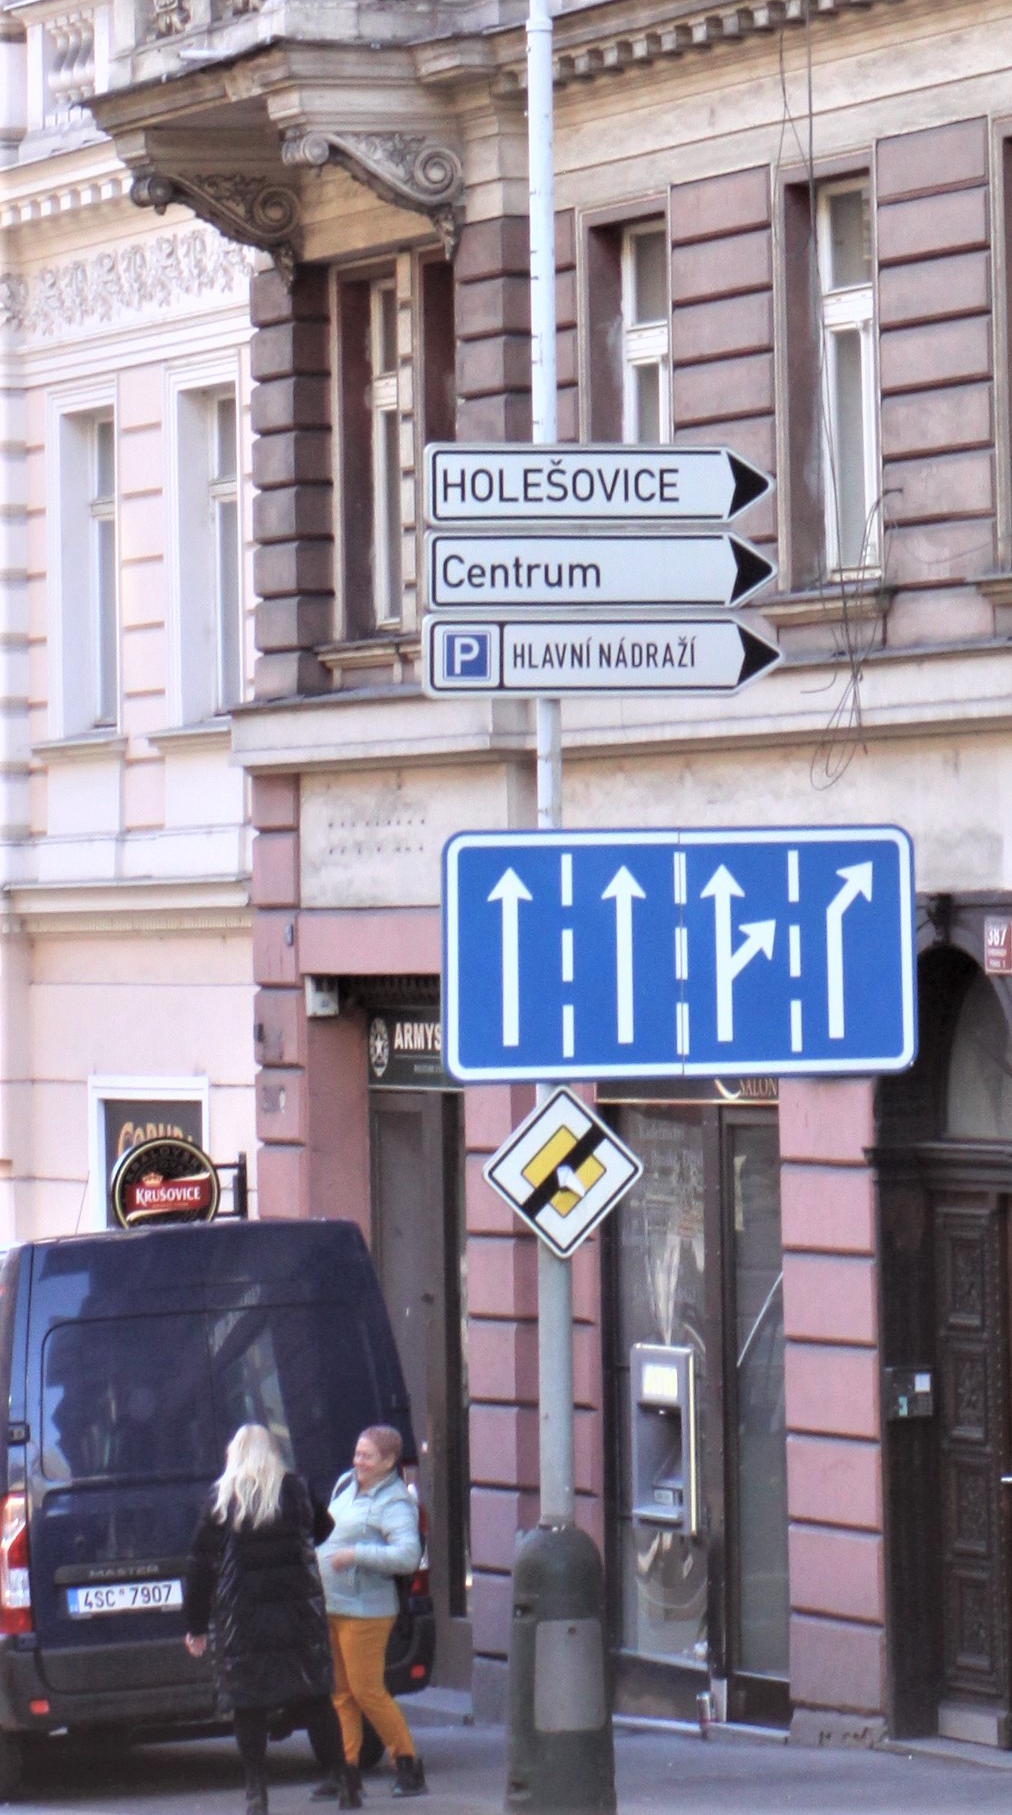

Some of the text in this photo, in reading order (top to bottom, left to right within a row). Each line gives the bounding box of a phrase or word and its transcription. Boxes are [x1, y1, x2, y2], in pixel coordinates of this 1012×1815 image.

[441, 459, 680, 503] HOLEŠOVICE
[441, 555, 602, 588] Centrum
[453, 636, 697, 675] P HLAVNÍ NÁDRAŽÍ
[83, 1584, 173, 1610] 4SC 7907
